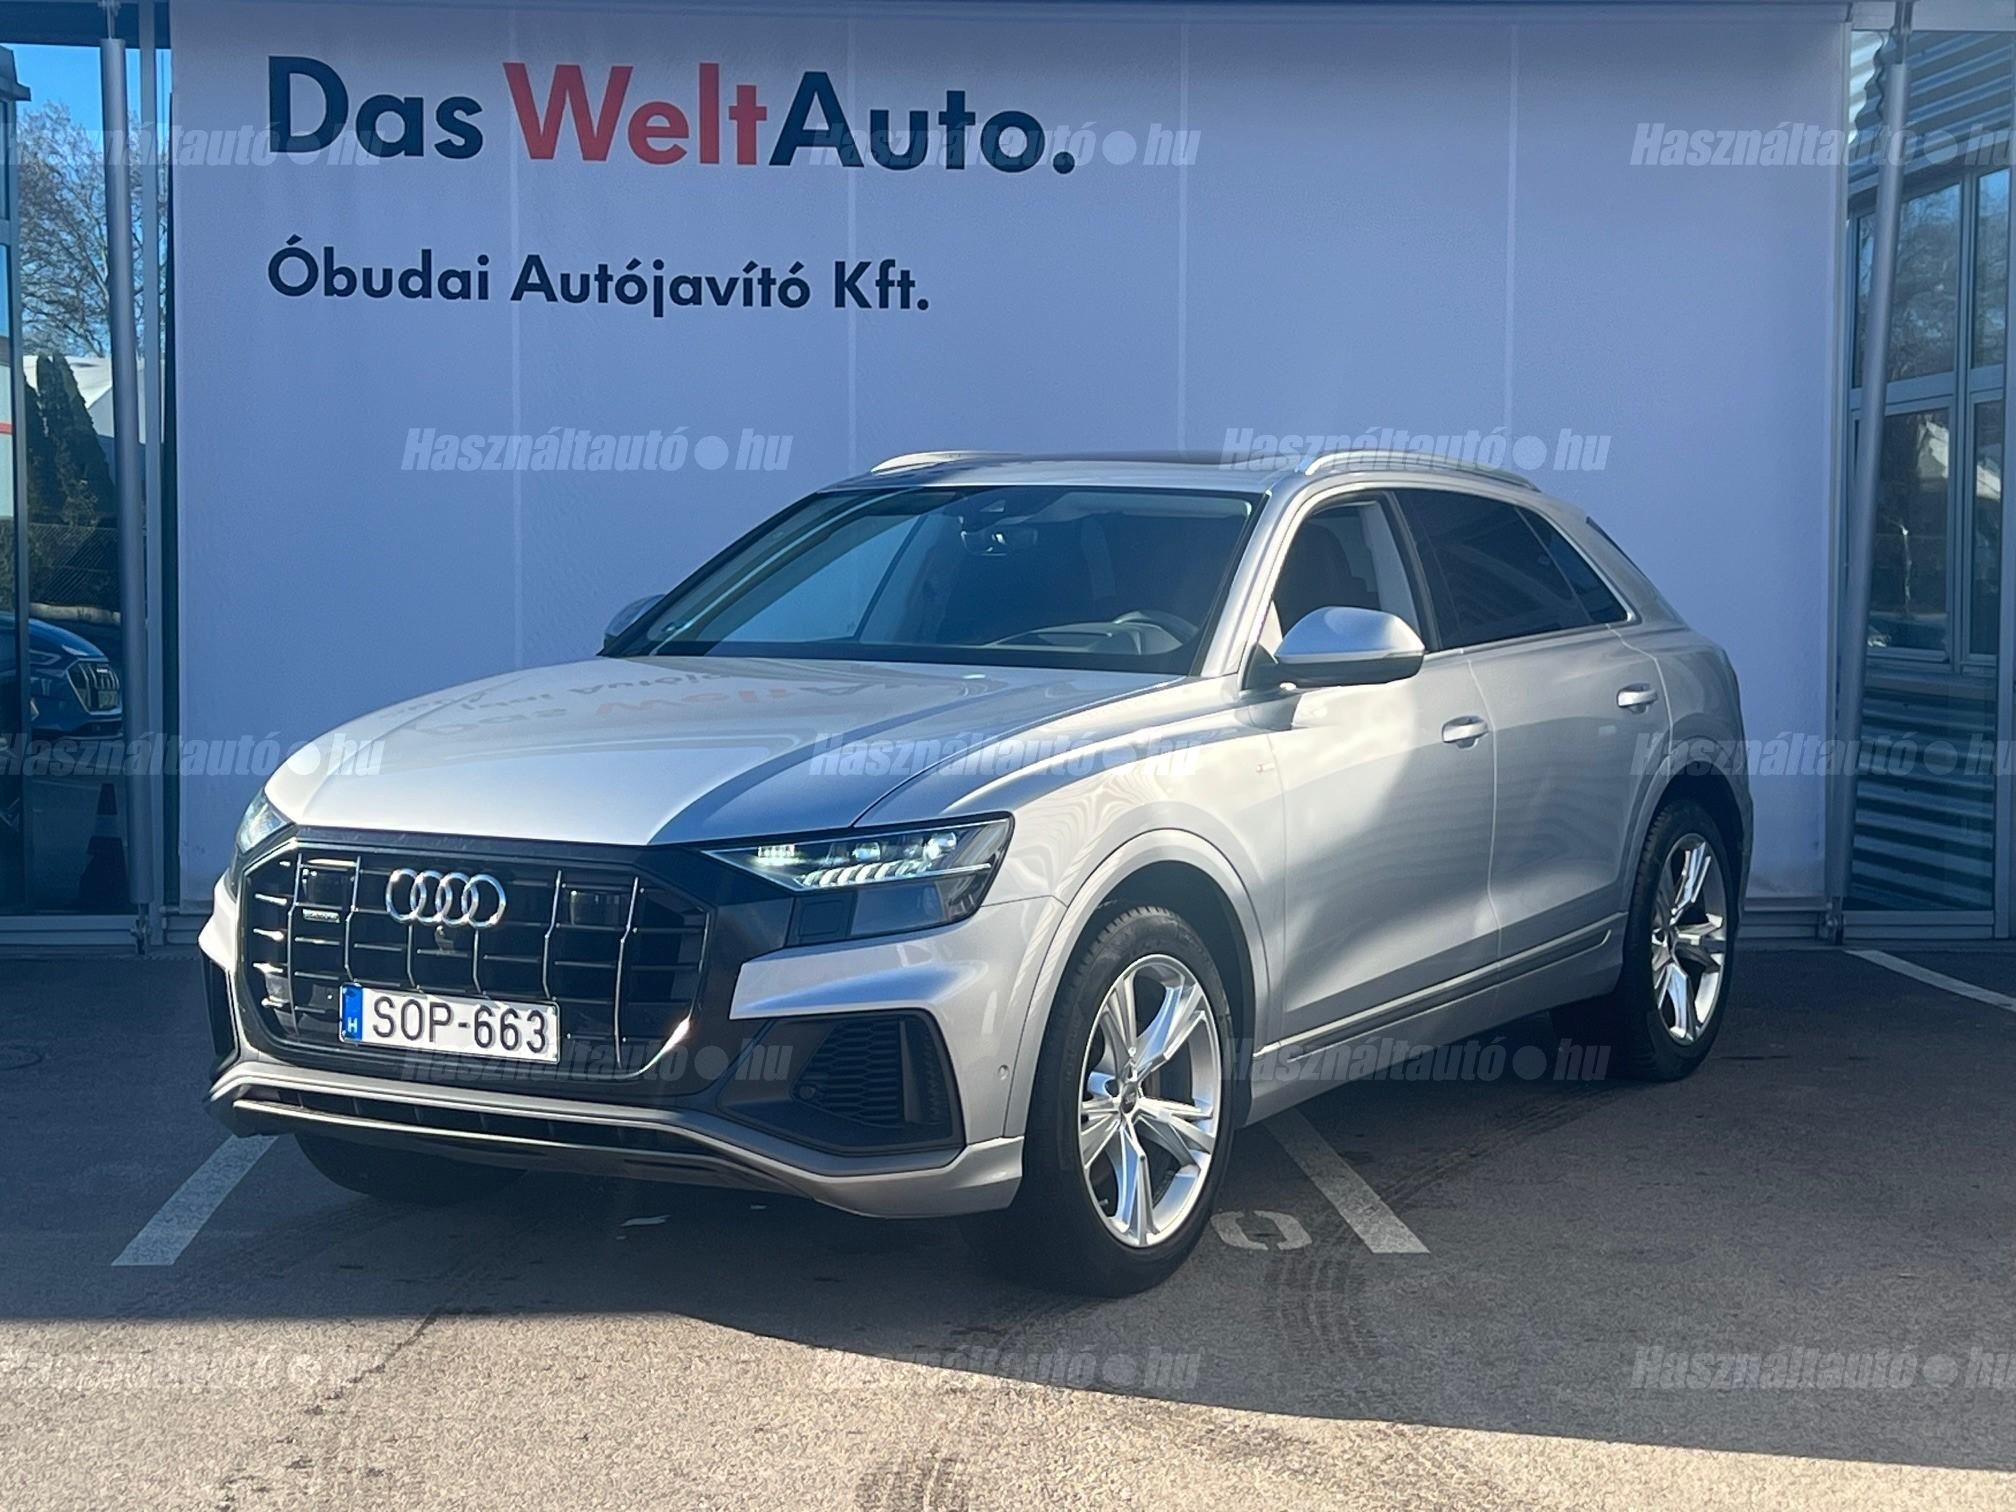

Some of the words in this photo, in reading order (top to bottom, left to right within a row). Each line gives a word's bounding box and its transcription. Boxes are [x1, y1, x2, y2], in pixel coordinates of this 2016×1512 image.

[267, 54, 484, 161] Das
[501, 61, 1076, 175] WeltAuto.
[267, 234, 490, 301] Óbudai
[510, 253, 811, 318] Autójavító
[833, 258, 930, 312] Kft.
[346, 1017, 359, 1034] H
[372, 996, 546, 1053] SOP-663
